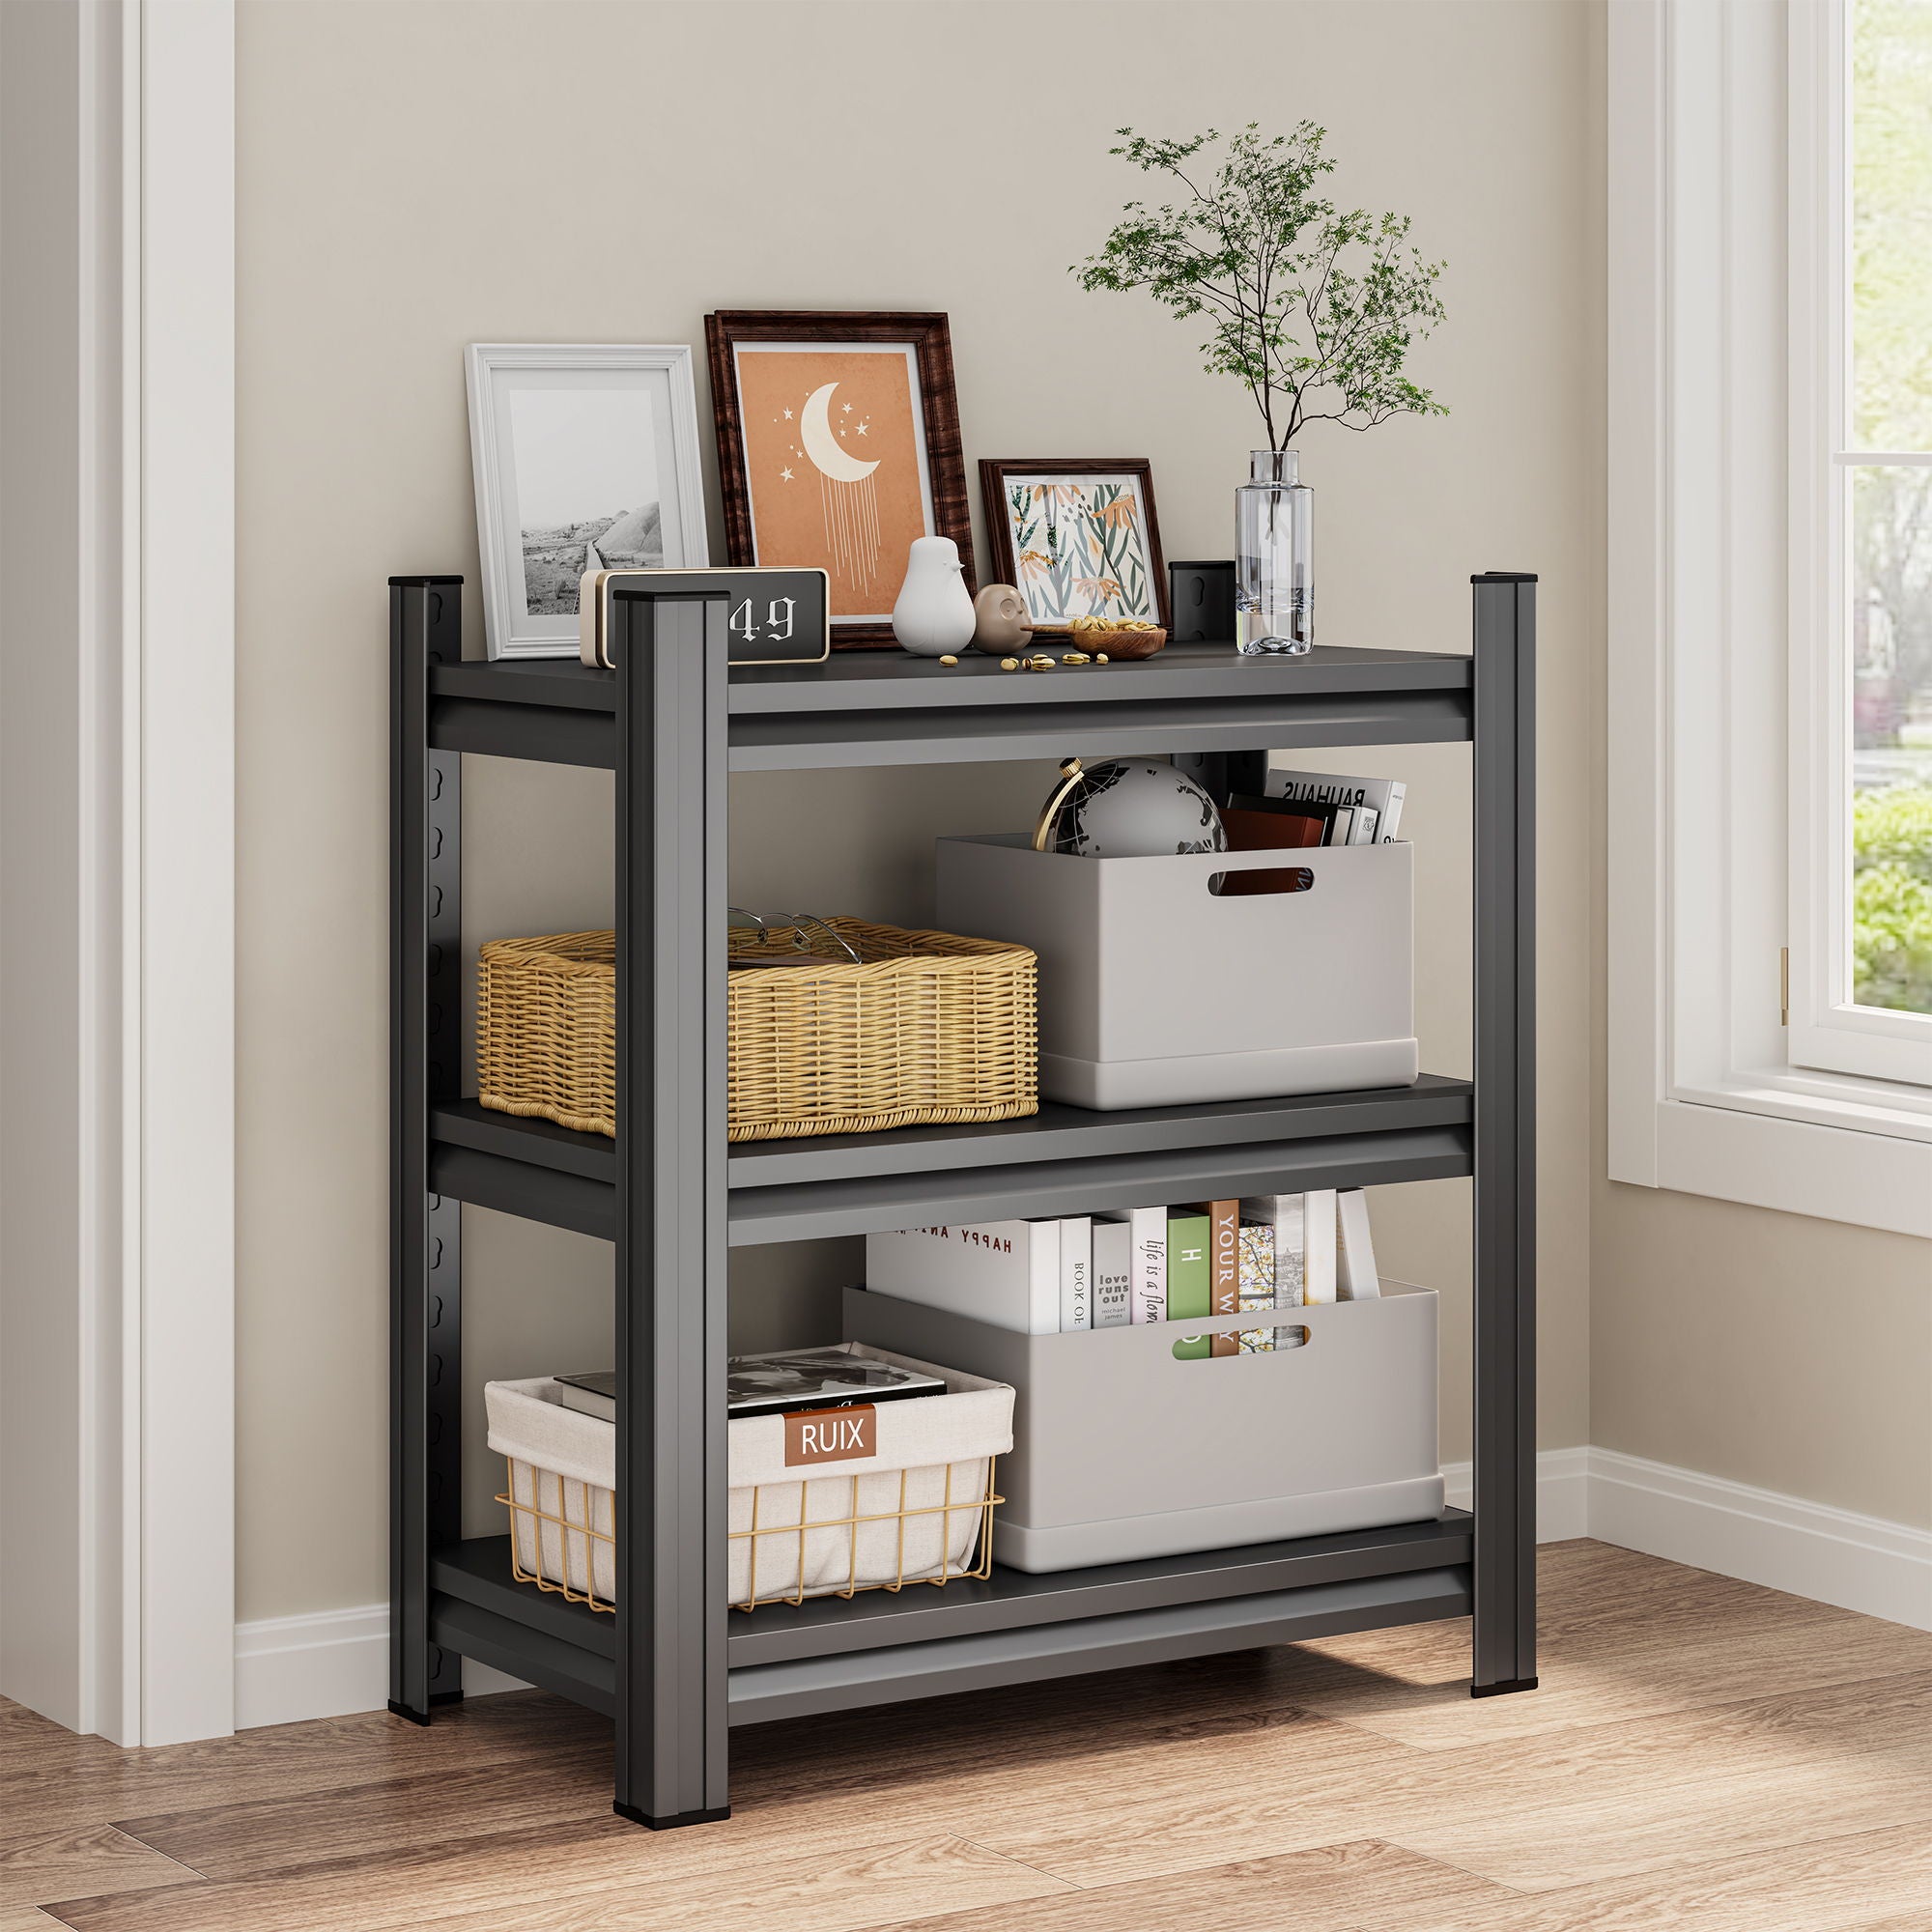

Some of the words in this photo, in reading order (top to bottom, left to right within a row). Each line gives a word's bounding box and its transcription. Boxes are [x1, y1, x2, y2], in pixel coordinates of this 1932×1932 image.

[729, 597, 797, 642] 49
[1140, 1239, 1164, 1261] life
[1219, 1214, 1235, 1286] YOUR
[1146, 1265, 1161, 1276] is
[1099, 1275, 1128, 1285] love
[1146, 1281, 1158, 1290] a
[1098, 1285, 1129, 1294] runs
[1102, 1293, 1125, 1304] out
[1219, 1292, 1235, 1343] WY
[802, 1418, 865, 1455] RUIX
